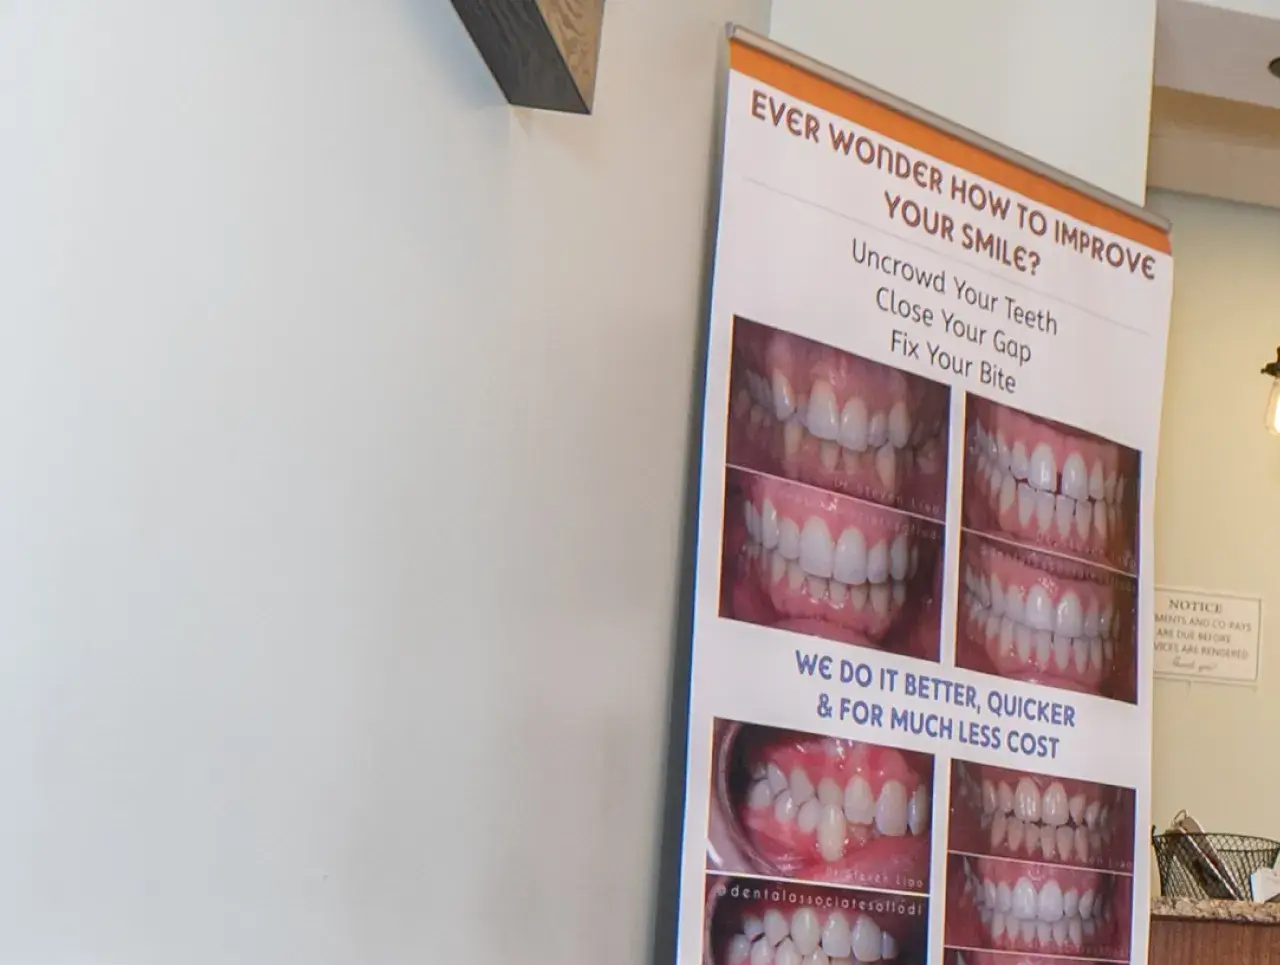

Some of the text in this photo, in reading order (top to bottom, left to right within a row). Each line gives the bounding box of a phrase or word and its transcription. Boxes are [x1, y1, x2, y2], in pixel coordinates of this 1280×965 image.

[751, 89, 1155, 280] EVER WONDER HOW TO IMPROVE
[883, 191, 1041, 277] YOUR SMILE?
[852, 238, 1058, 335] Uncrowd Your Teeth
[876, 287, 1032, 366] Close Your Gap
[891, 330, 1017, 394] Fix Your Bite
[1168, 599, 1222, 613] NOTICE
[795, 649, 1076, 728] WE DO IT BETTER, QUICKER
[817, 694, 1060, 759] & FOR MUCH LESS COST
